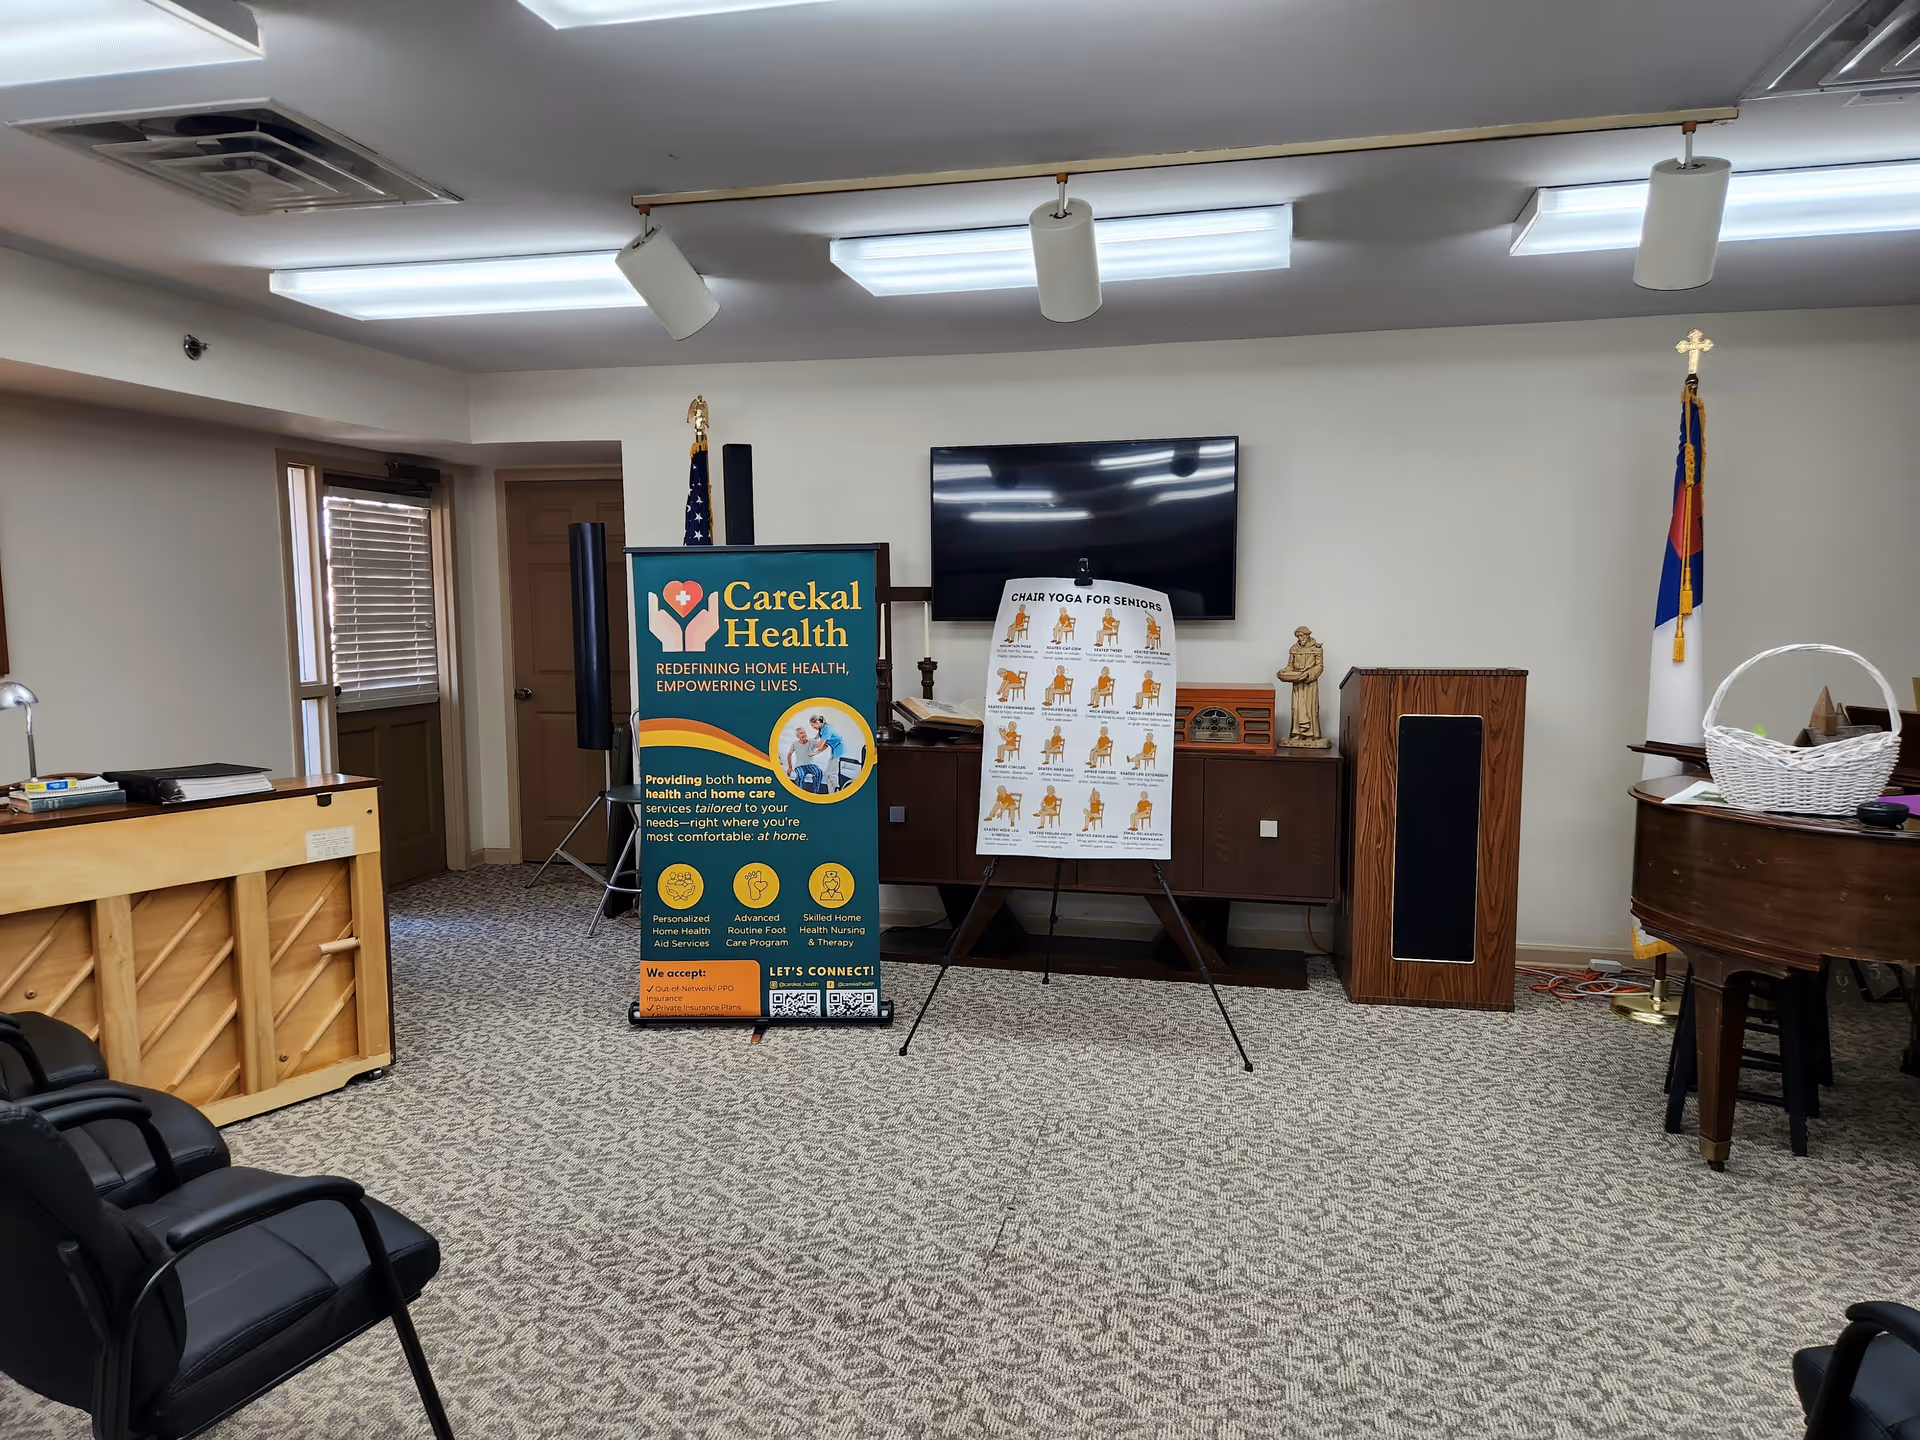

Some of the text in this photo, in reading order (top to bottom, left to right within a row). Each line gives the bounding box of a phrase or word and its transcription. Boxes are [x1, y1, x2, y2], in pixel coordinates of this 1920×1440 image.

[724, 580, 861, 610] Carekal
[1012, 593, 1162, 612] CHAIR YOGA FOR SENIORS
[724, 618, 848, 647] Health
[656, 662, 850, 676] REDEFINING HOME HEALTH,
[657, 680, 801, 692] EMPOWERING LIVES.
[645, 774, 772, 787] Providing both home
[645, 789, 775, 799] health and home care
[646, 803, 788, 814] services tailored to your
[722, 817, 759, 827] where
[646, 831, 808, 842] most comfortable: at home.
[653, 914, 710, 923] Personalized
[734, 914, 779, 922] Advanced
[803, 914, 861, 922] Skilled Home
[652, 926, 710, 935] Home Health
[728, 926, 786, 934] Routine Foot
[799, 926, 865, 936] Health Nursing
[654, 939, 709, 947] Aid Services
[726, 938, 789, 948] Care Program
[818, 938, 854, 948] Therapy
[646, 968, 706, 980] We accept:
[808, 966, 874, 976] CONNECT!
